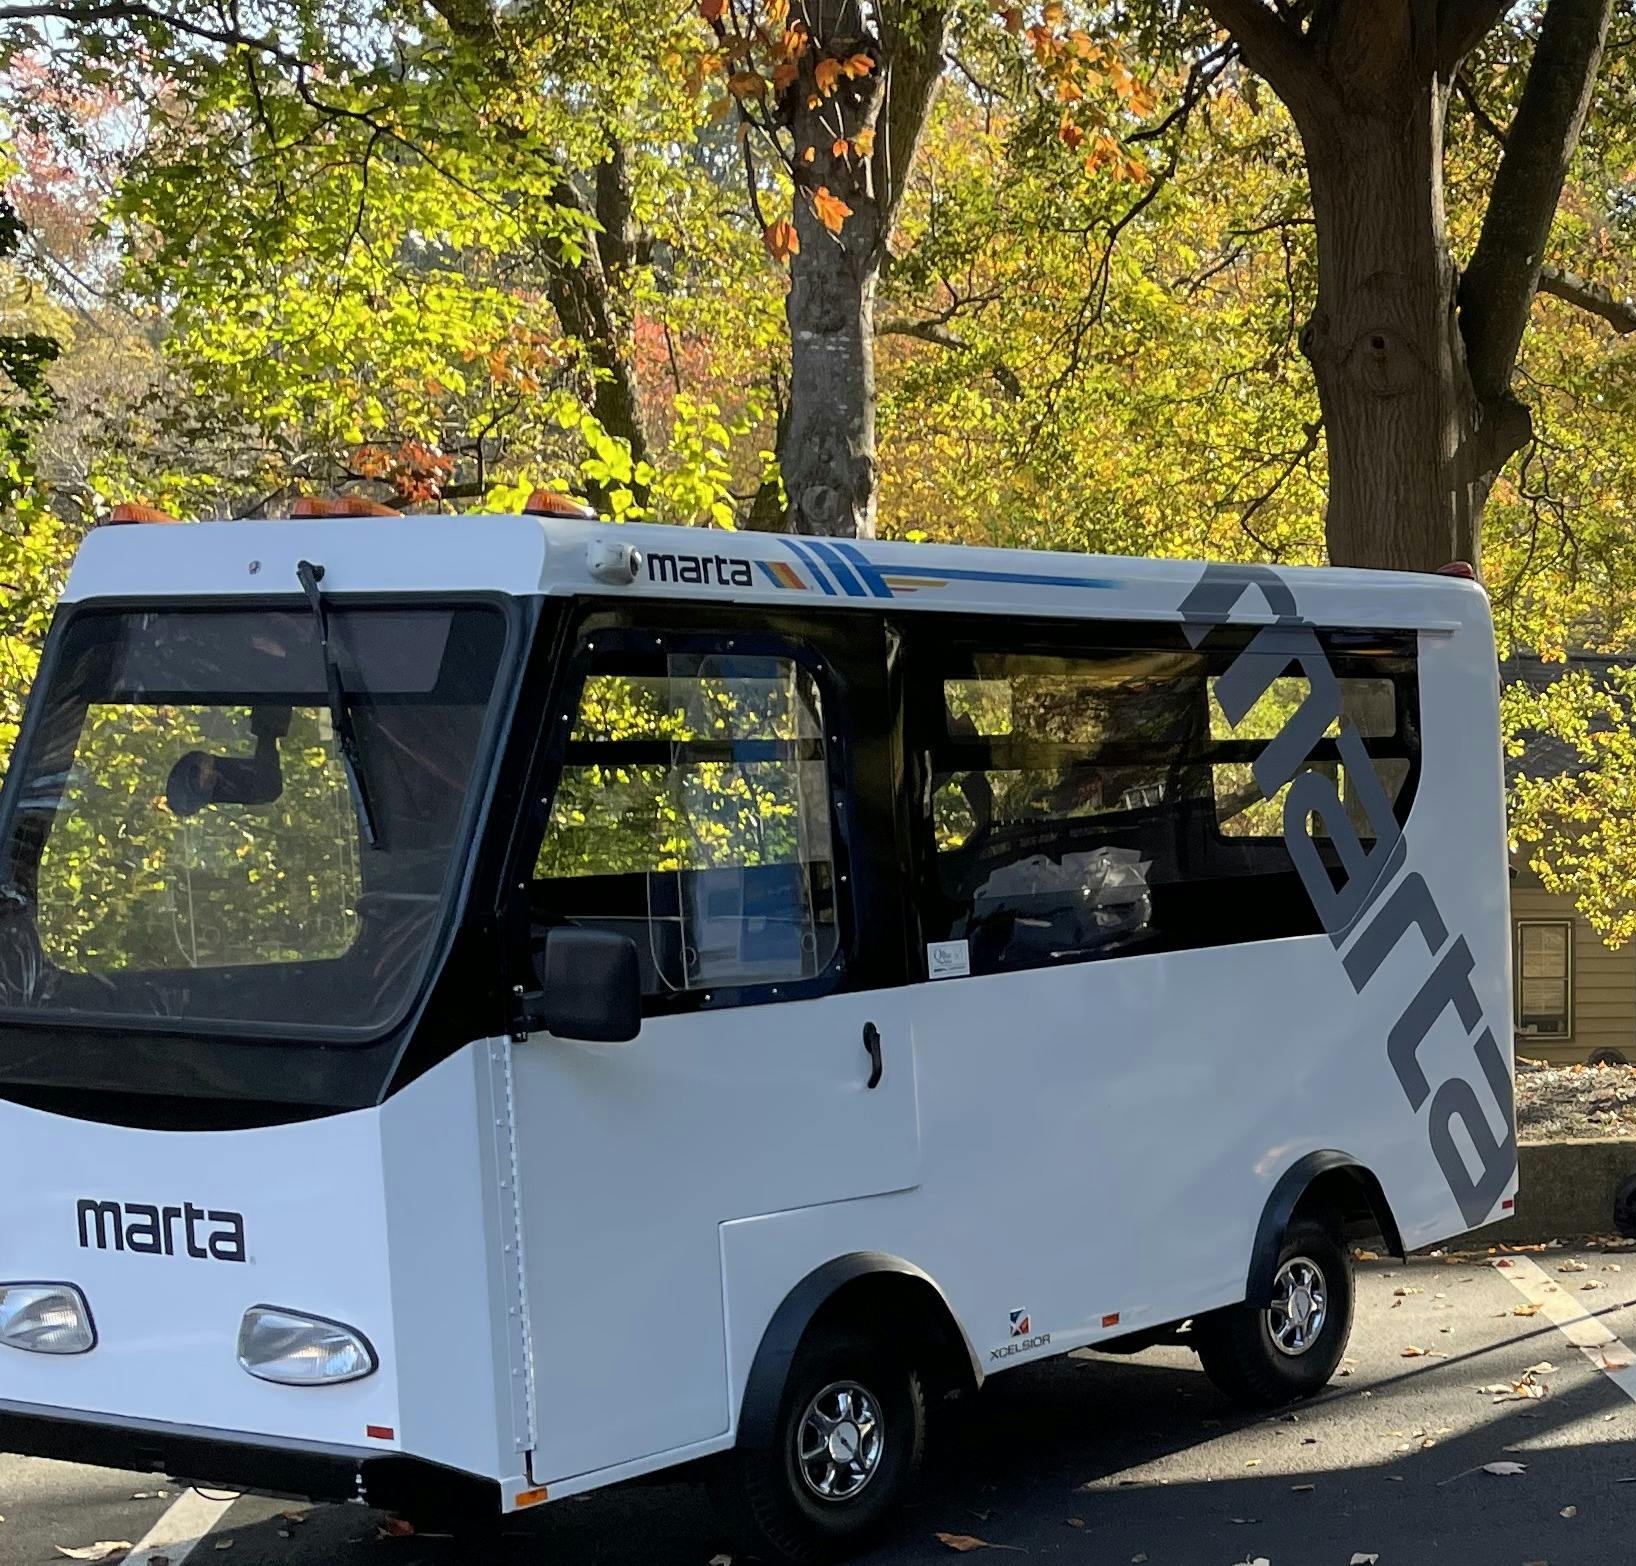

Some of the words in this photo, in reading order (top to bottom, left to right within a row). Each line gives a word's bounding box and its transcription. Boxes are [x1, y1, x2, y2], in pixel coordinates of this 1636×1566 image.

[647, 553, 753, 587] marta
[1177, 562, 1518, 1228] marta
[76, 1199, 246, 1262] marta
[990, 1333, 1051, 1361] XCELSIOR
